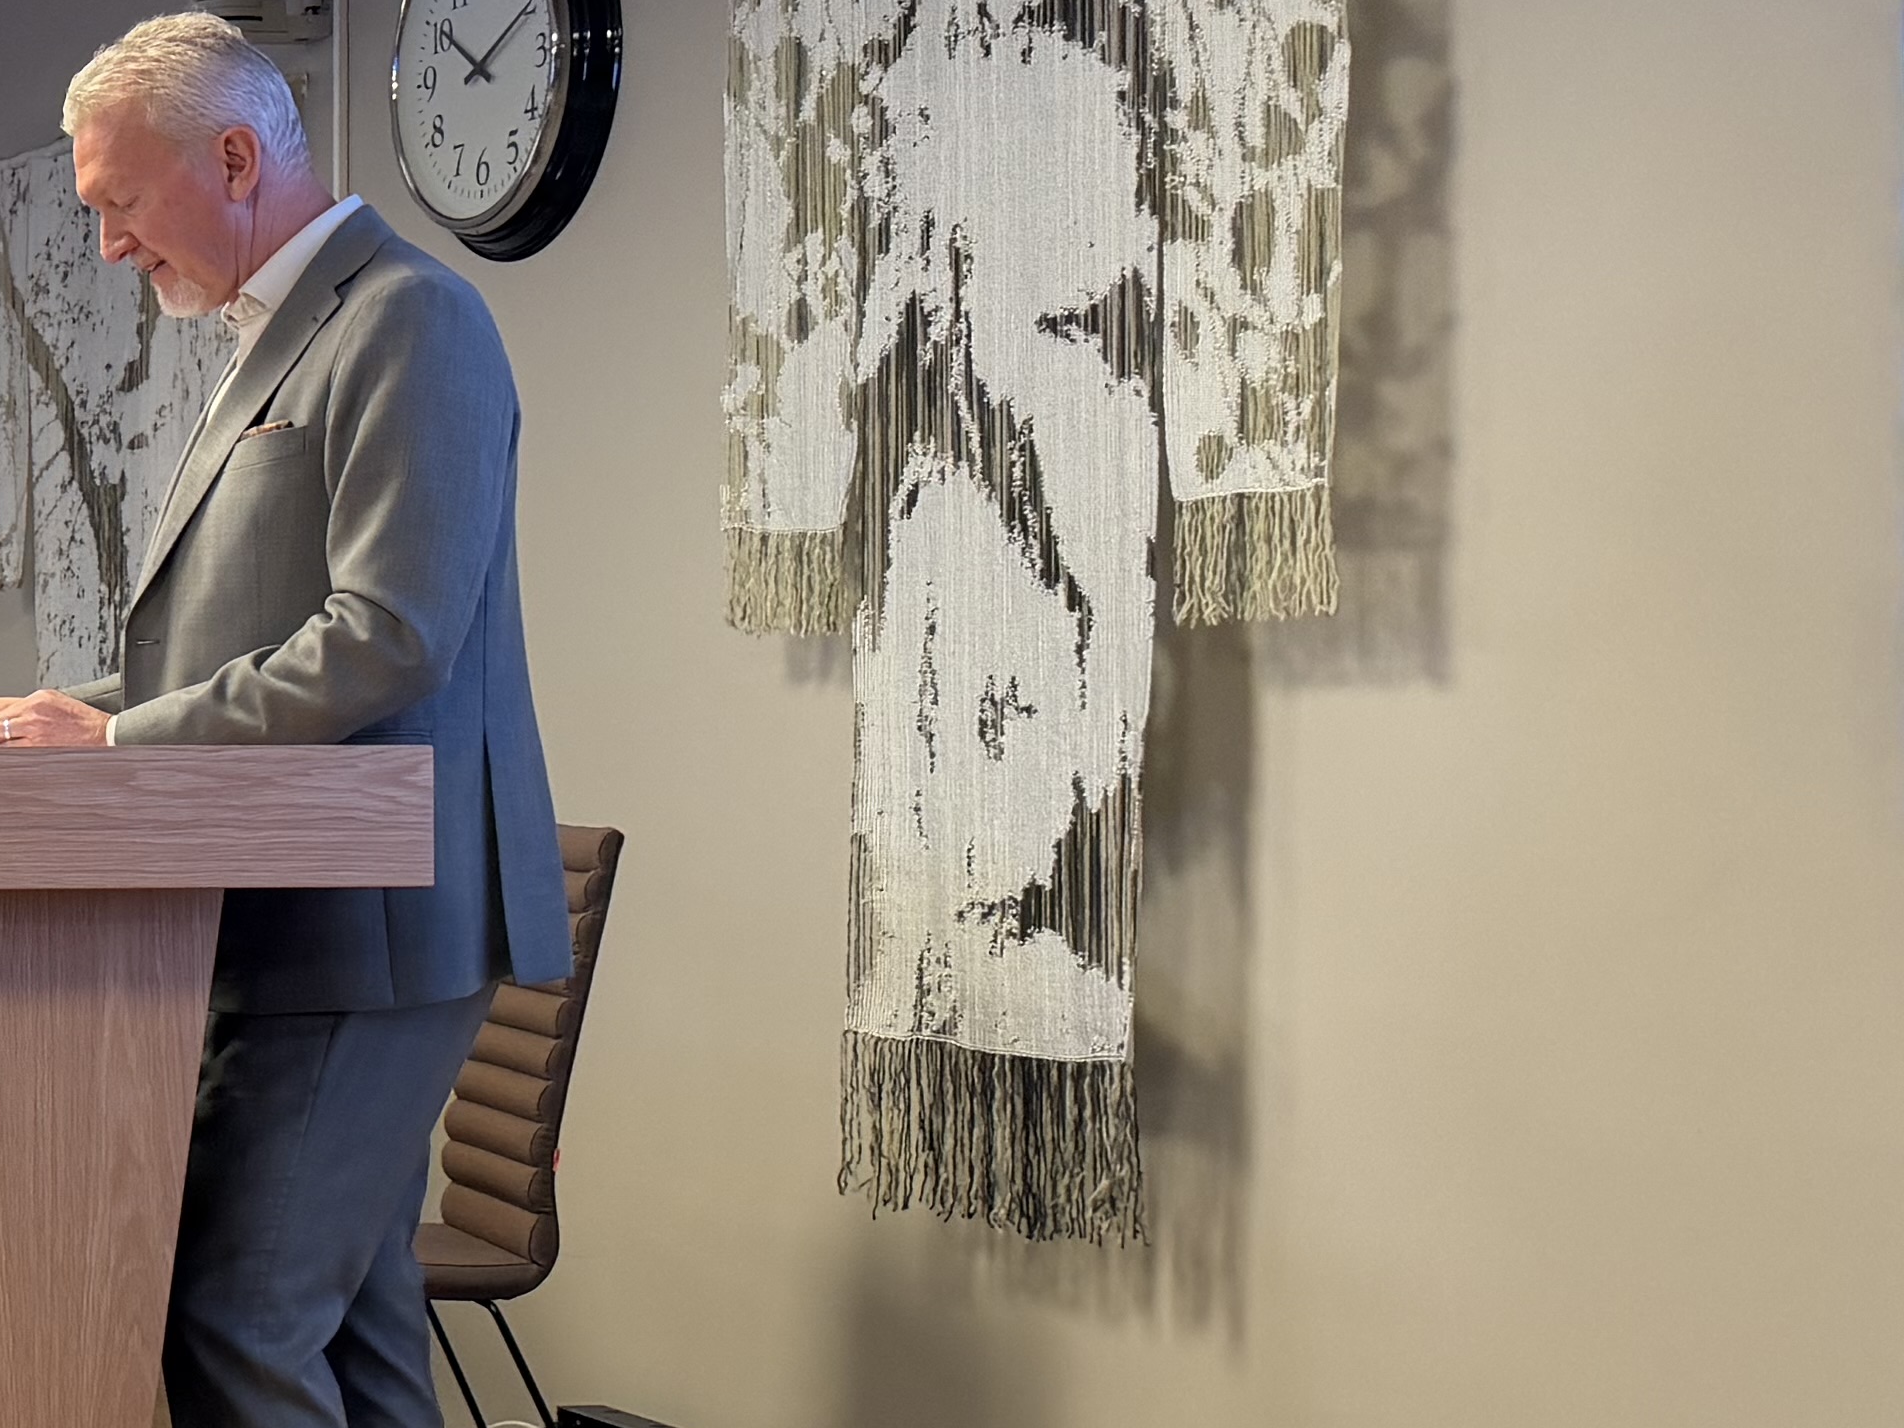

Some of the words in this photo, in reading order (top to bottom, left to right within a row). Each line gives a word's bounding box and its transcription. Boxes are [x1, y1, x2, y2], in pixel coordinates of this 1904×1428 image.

[432, 18, 454, 55] 10
[535, 32, 547, 68] 3
[424, 66, 437, 102] 9
[524, 84, 538, 121] 4
[430, 114, 444, 148] 8
[505, 129, 519, 166] 5
[453, 144, 465, 178] 7
[476, 148, 490, 186] 6
